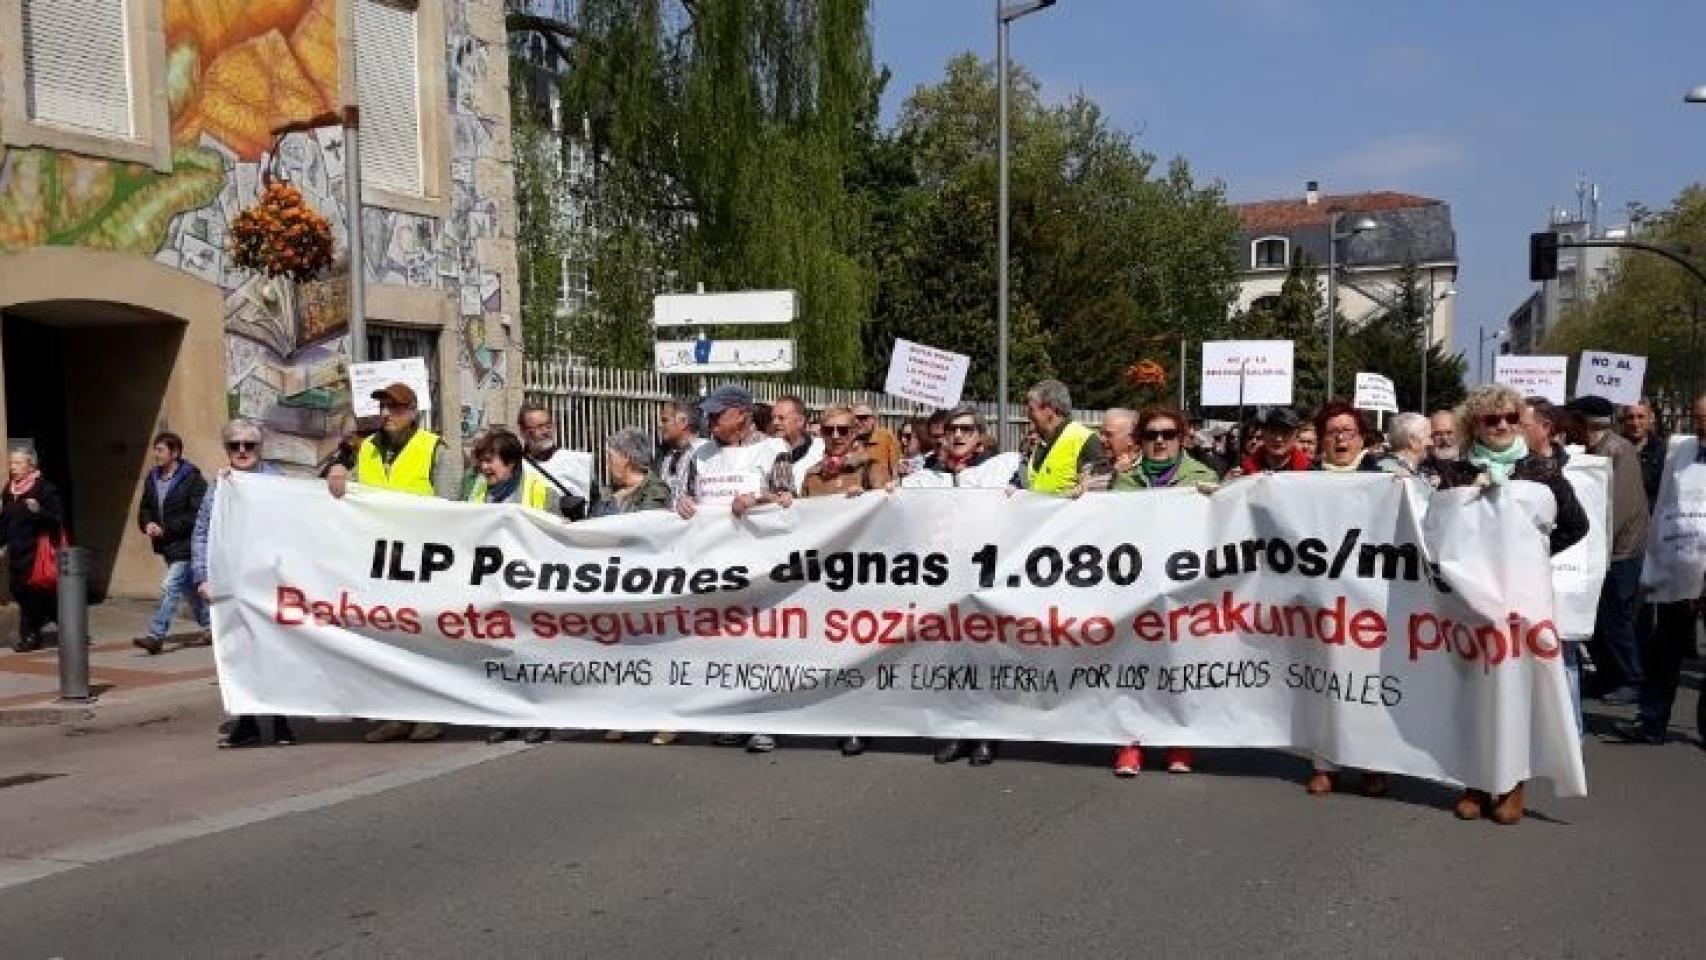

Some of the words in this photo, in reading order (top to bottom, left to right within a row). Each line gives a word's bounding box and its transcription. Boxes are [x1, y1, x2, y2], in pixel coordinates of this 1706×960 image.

[1592, 356, 1609, 367] NO
[370, 538, 455, 582] ILP
[470, 545, 749, 594] Pensiones
[768, 549, 949, 592] dignas
[971, 543, 1143, 588] 1.080
[1164, 528, 1452, 594] euros/m
[275, 585, 422, 635] Babes
[437, 602, 515, 639] eta
[530, 604, 808, 645] segurtasun
[824, 602, 1115, 646] sozialerako
[1133, 590, 1388, 649] erakunde
[1408, 611, 1560, 675] propio
[484, 659, 652, 686] PLATAFORMAS
[669, 659, 693, 686] DE
[705, 661, 866, 693] PENSIONISTAS
[877, 664, 902, 690] DE
[910, 663, 984, 691] EUSKAL
[990, 663, 1059, 693] HERRIA
[1069, 663, 1112, 690] POR
[1116, 663, 1149, 690] LOS
[1157, 659, 1271, 694] DERECHOS
[1285, 663, 1402, 707] SOCIALES
